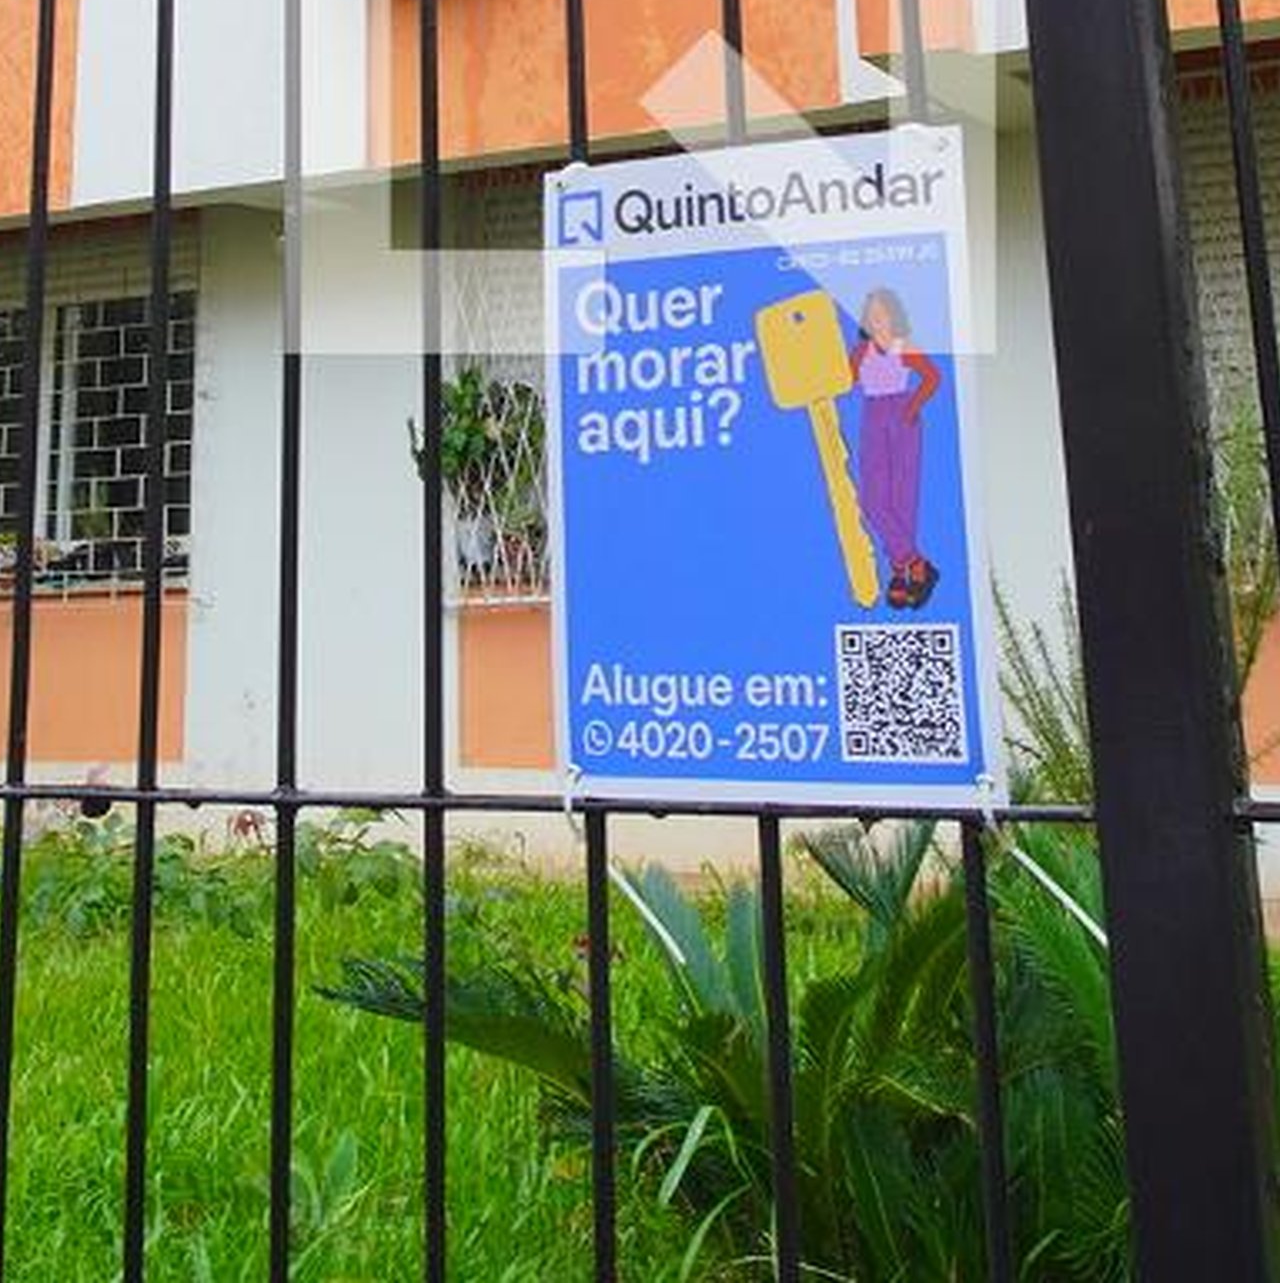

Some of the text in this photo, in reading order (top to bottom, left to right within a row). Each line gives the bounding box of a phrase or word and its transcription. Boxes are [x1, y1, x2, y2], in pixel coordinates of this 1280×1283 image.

[614, 163, 944, 234] QuintoAndar
[575, 283, 723, 336] Quer
[576, 340, 755, 394] morar
[577, 390, 742, 463] aqui?
[581, 663, 828, 715] Alugue em:
